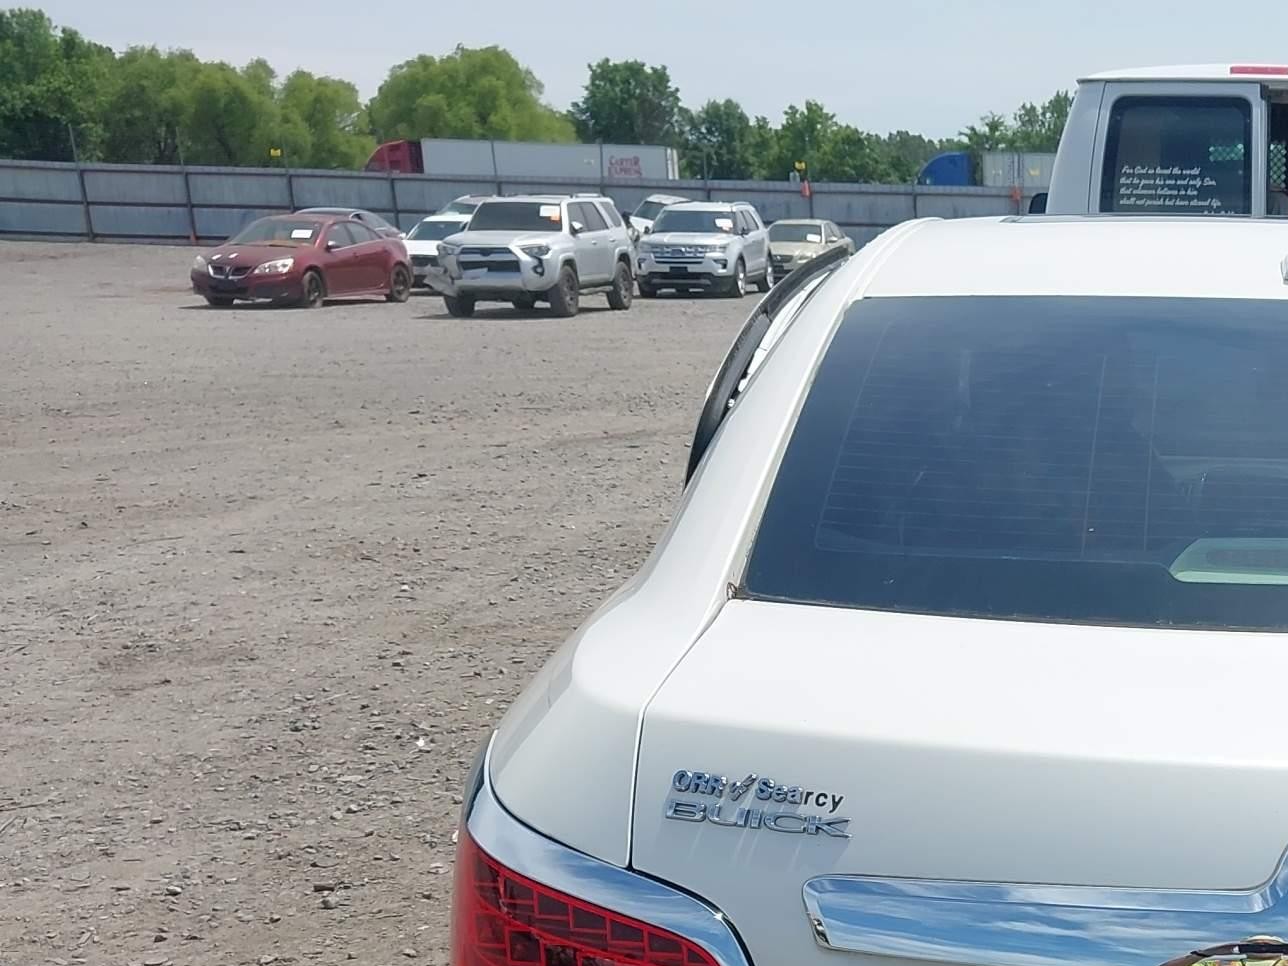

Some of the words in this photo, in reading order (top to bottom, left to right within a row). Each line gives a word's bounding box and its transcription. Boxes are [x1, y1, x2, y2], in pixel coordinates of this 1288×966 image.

[1135, 166, 1147, 174] God
[1156, 166, 1172, 174] loved
[1183, 166, 1200, 174] world
[1120, 176, 1132, 184] that
[1140, 179, 1154, 189] gave
[1156, 177, 1165, 185] his
[1176, 177, 1188, 185] and
[1189, 178, 1201, 188] only
[1145, 198, 1163, 206] perish
[1190, 198, 1211, 206] eternal
[672, 769, 727, 798] ORR
[756, 777, 844, 813] Searcy
[665, 799, 853, 839] BUICK
